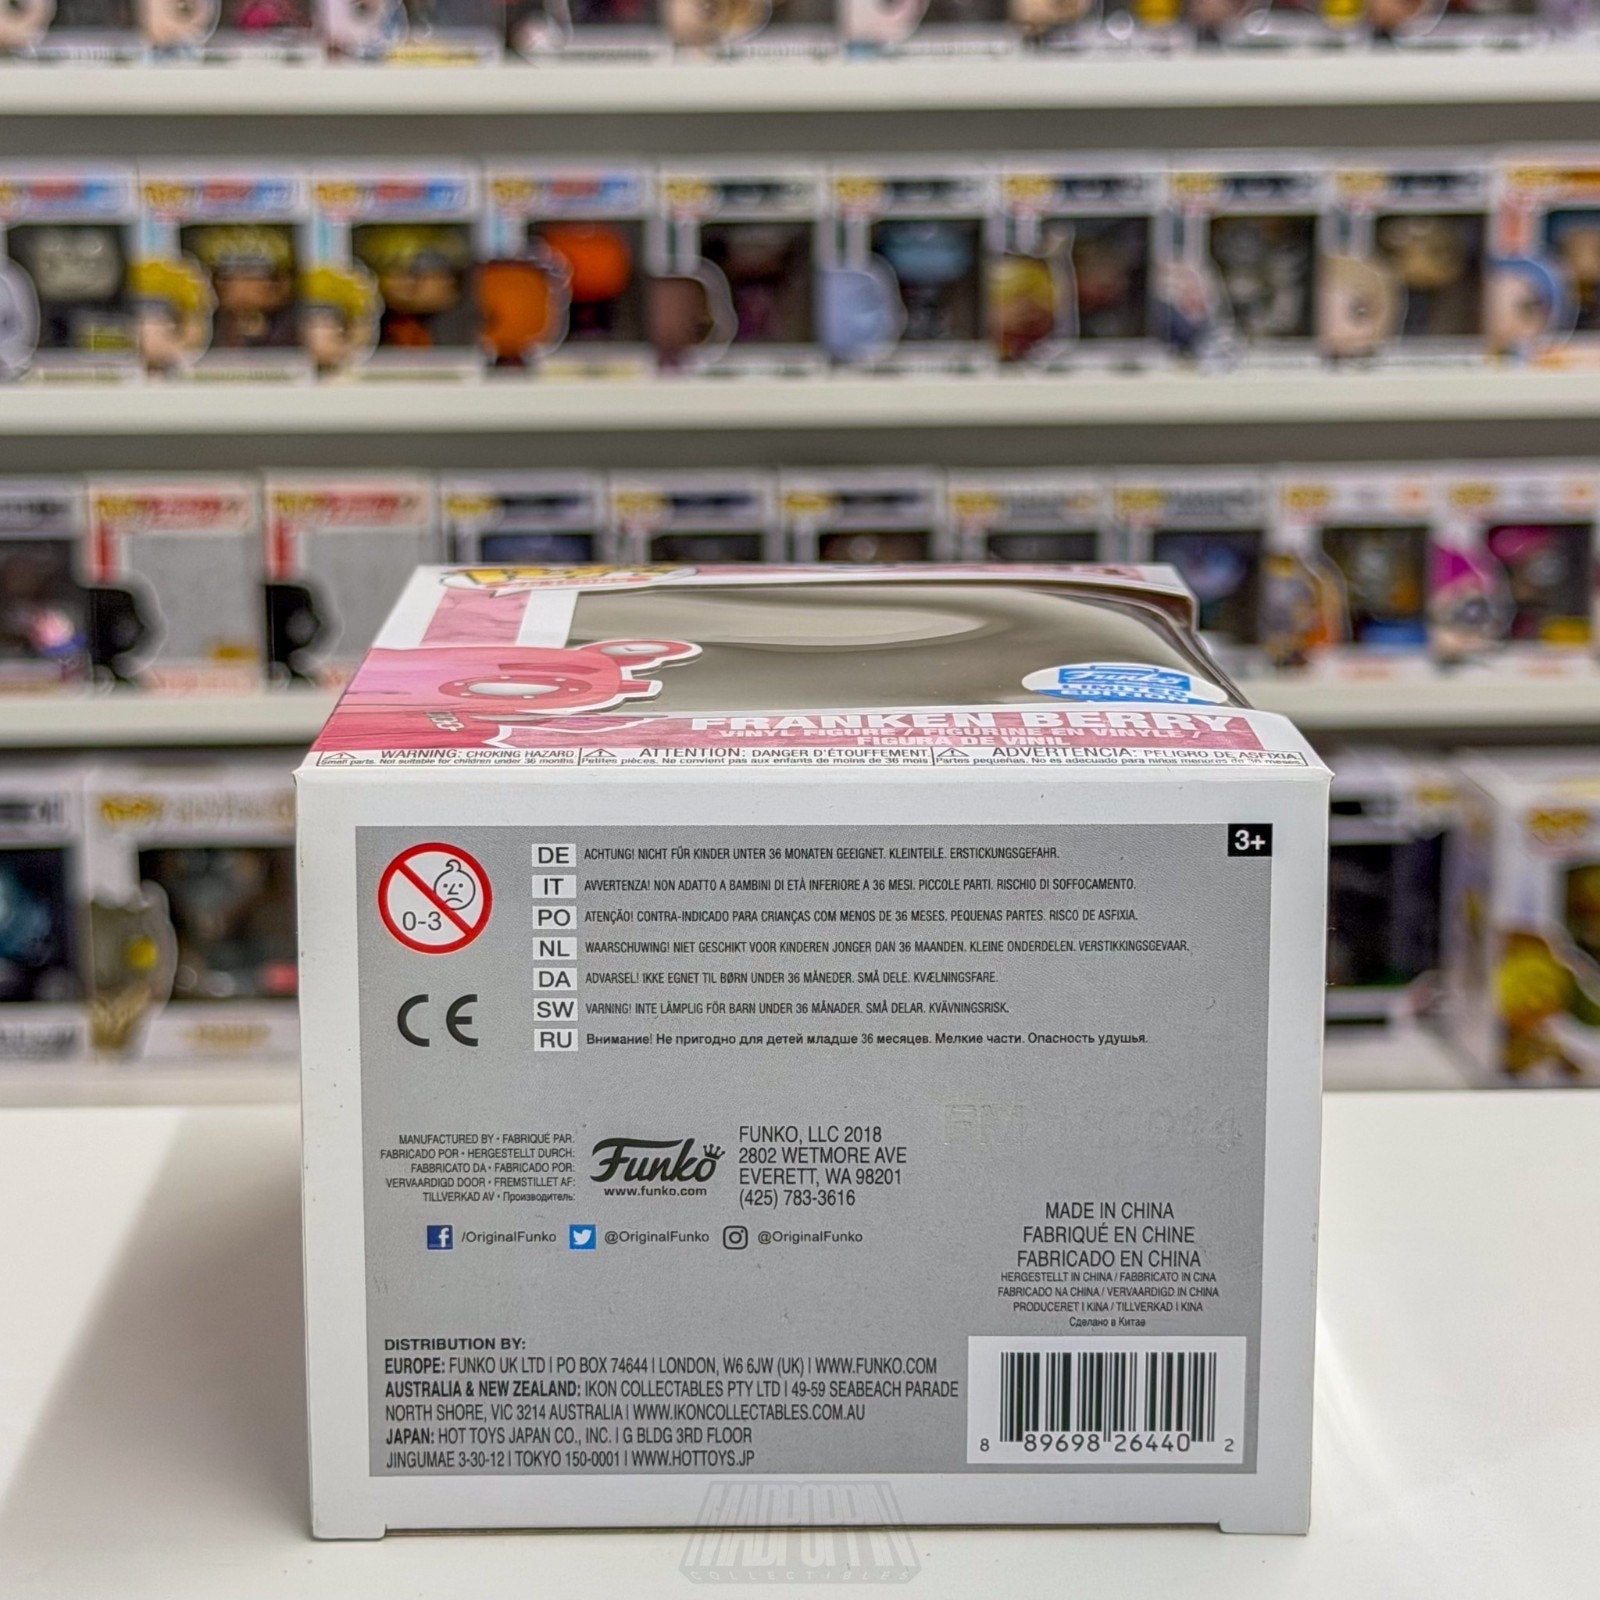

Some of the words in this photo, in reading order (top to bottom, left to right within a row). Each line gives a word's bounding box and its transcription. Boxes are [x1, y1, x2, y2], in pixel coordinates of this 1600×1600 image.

[692, 713, 996, 731] FRANKEN
[1021, 712, 1232, 733] BERRY
[721, 729, 797, 738] VINYL
[803, 728, 895, 737] FIGURE
[923, 727, 1040, 737] FIGURINE
[1050, 727, 1082, 737] EN
[1091, 727, 1179, 738] VINYLE
[857, 735, 957, 746] FIGURA
[962, 735, 994, 746] DE
[999, 735, 1071, 746] VINIL
[466, 750, 522, 759] CHOKING
[525, 750, 575, 758] HAZARD
[639, 747, 746, 758] ATTENTION:
[752, 748, 810, 758] DANGER
[813, 747, 931, 758] D'ÉTOUFFEMENT.
[991, 746, 1139, 758] ADVERTENCIA:
[1144, 749, 1215, 759] PELIGRO
[1219, 750, 1237, 760] DE
[1239, 750, 1302, 761] ASFIXIA.
[1233, 829, 1266, 852] 3+
[538, 845, 570, 866] DE
[583, 847, 635, 862] ACHTUNG!
[637, 847, 668, 862] NICHT
[671, 844, 691, 862] FÜR
[693, 847, 731, 862] KINDER
[733, 847, 767, 861] UNTER
[769, 847, 782, 861] 36
[784, 846, 834, 861] MONATEN
[836, 846, 886, 861] GEEIGNET.
[889, 846, 947, 861] KLEINTEILE.
[949, 846, 1060, 860] ERSTICKUNGSGEFAHR.
[543, 876, 564, 897] IT
[402, 911, 442, 931] 0-3
[538, 907, 571, 928] PO
[538, 938, 570, 959] NL
[585, 940, 670, 955] WAARSCHUWING!
[673, 940, 696, 955] NIET
[698, 940, 747, 955] GESCHIKT
[749, 940, 777, 954] VOOR
[779, 940, 830, 954] KINDEREN
[831, 940, 872, 954] JONGER
[875, 939, 896, 954] DAN
[899, 939, 912, 954] 36
[914, 939, 967, 954] MAANDEN.
[969, 939, 1004, 954] KLEINE
[1007, 939, 1076, 954] ONDERDELEN.
[1078, 939, 1190, 953] VERSTIKKINGSGEVAAR.
[538, 969, 571, 990] DA
[536, 999, 575, 1020] SW
[539, 1030, 573, 1050] RU
[586, 1032, 653, 1046] Внимание!
[656, 1032, 673, 1046] Не
[675, 1032, 737, 1046] пригодно
[739, 1032, 764, 1046] для
[765, 1032, 804, 1046] детей
[807, 1032, 859, 1046] младше
[861, 1032, 874, 1046] 36
[876, 1032, 932, 1046] месяцев.
[935, 1032, 984, 1046] Мелкие
[986, 1032, 1025, 1046] части.
[1027, 1032, 1095, 1046] Опасность
[1097, 1032, 1148, 1046] удушья.
[399, 1133, 479, 1145] MANUFACTURED
[481, 1133, 495, 1145] BY
[502, 1130, 551, 1145] FABRIQUÉ
[553, 1133, 576, 1145] PAR:
[739, 1125, 803, 1146] FUNKO,
[808, 1125, 839, 1143] LLC
[844, 1125, 883, 1143] 2018
[589, 1137, 726, 1183] Funko
[739, 1147, 777, 1164] 2802
[781, 1146, 871, 1164] WETMORE
[874, 1146, 907, 1164] AVE
[739, 1168, 820, 1188] EVERETT,
[825, 1168, 853, 1185] WA
[855, 1168, 901, 1185] 98201
[422, 1191, 481, 1202] TILLVERKAD
[482, 1191, 495, 1202] AV
[503, 1191, 576, 1202] Производитель:
[603, 1185, 707, 1197] www.funko.com
[739, 1189, 779, 1210] (425)
[783, 1189, 856, 1207] 783-3616
[1045, 1202, 1095, 1219] MADE
[1100, 1202, 1116, 1219] IN
[1121, 1202, 1175, 1219] CHINA
[461, 1230, 557, 1244] /OriginalFunko
[604, 1230, 710, 1244] @OriginalFunko
[757, 1230, 863, 1244] @OriginalFunko
[1023, 1222, 1109, 1243] FABRIQUÉ
[1114, 1226, 1137, 1243] EN
[1142, 1226, 1195, 1243] CHINE
[1017, 1250, 1116, 1267] FABRICADO
[1120, 1250, 1143, 1267] EN
[1148, 1250, 1202, 1267] CHINA
[1001, 1272, 1069, 1282] HERGESTELLT
[1071, 1272, 1081, 1282] IN
[1082, 1272, 1113, 1282] CHINA
[1119, 1272, 1179, 1282] FABBRICATO
[1181, 1272, 1192, 1282] IN
[1193, 1272, 1217, 1282] CINA
[1069, 1317, 1109, 1327] Сделано
[1110, 1317, 1117, 1327] в
[1118, 1317, 1147, 1327] Китае
[384, 1338, 496, 1351] DISTRIBUTION
[500, 1338, 526, 1351] BY:
[385, 1357, 446, 1375] EUROPE:
[449, 1357, 496, 1375] FUNKO
[499, 1357, 518, 1375] UK
[521, 1357, 546, 1375] LTD
[557, 1357, 577, 1375] PO
[579, 1357, 608, 1375] BOX
[611, 1357, 649, 1375] 74644
[659, 1356, 719, 1378] LONDON,
[723, 1356, 744, 1374] W6
[746, 1356, 774, 1374] 6JW
[777, 1356, 805, 1377] (UK)
[815, 1356, 937, 1374] WWW.FUNKO.COM
[385, 1381, 463, 1399] AUSTRALIA
[465, 1381, 475, 1399] &
[478, 1381, 510, 1399] NEW
[513, 1380, 581, 1399] ZEALAND:
[585, 1380, 617, 1399] IKON
[620, 1380, 724, 1399] COLLECTABLES
[727, 1380, 754, 1398] PTY
[757, 1380, 781, 1398] LTD
[791, 1379, 826, 1398] 49-59
[829, 1379, 902, 1398] SEABEACH
[905, 1379, 959, 1398] PARADE
[385, 1428, 435, 1445] JAPAN:
[438, 1428, 465, 1445] HOT
[471, 1427, 506, 1445] TOYS
[508, 1427, 551, 1445] JAPAN
[554, 1427, 582, 1448] CO.,
[585, 1427, 612, 1444] INC.
[622, 1427, 633, 1444] G
[637, 1426, 673, 1444] BLDG
[676, 1426, 703, 1444] 3RD
[707, 1426, 753, 1444] FLOOR
[979, 1437, 990, 1453] 8
[1024, 1432, 1101, 1453] 89698
[1113, 1432, 1191, 1453] 26440
[1223, 1438, 1235, 1453] 2
[386, 1451, 455, 1468] JINGUMAE
[458, 1450, 505, 1468] 3-30-12
[515, 1450, 562, 1468] TOKYO
[565, 1450, 619, 1468] 150-0001
[631, 1449, 755, 1467] WWW.HOTTOYS.JP
